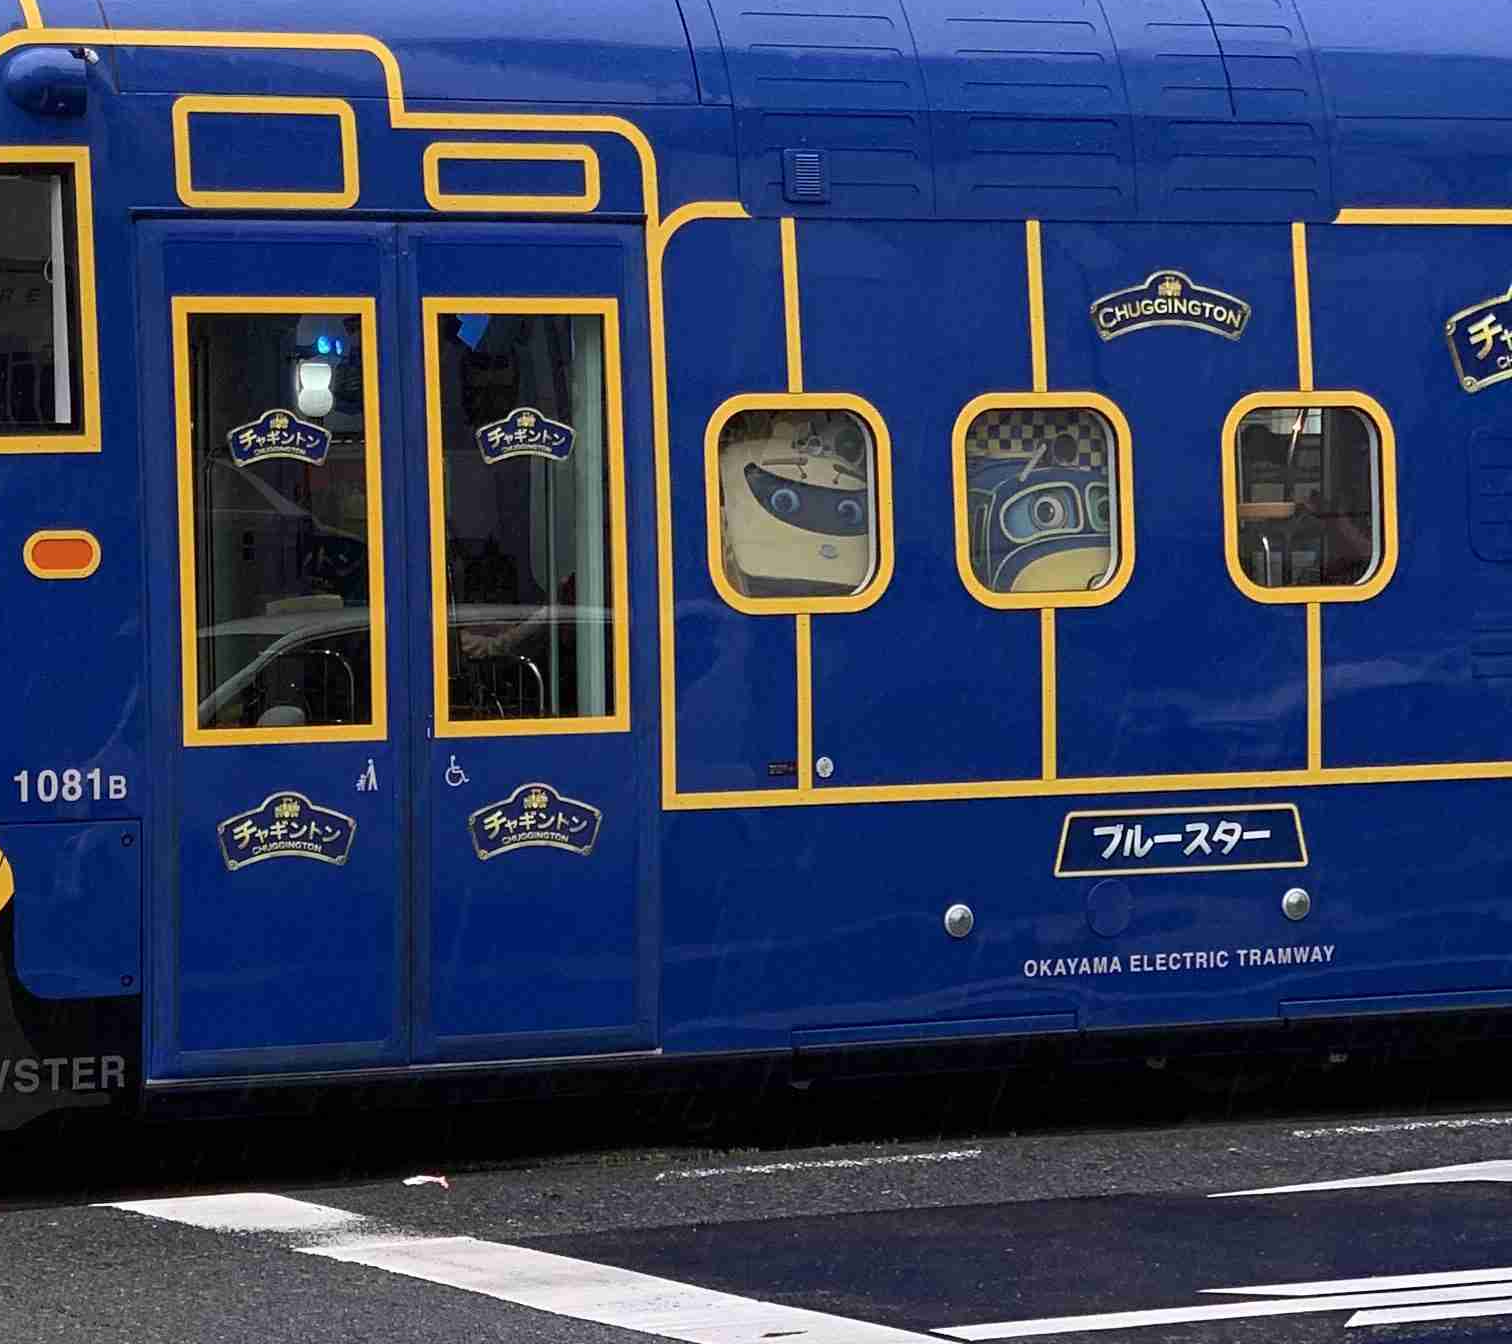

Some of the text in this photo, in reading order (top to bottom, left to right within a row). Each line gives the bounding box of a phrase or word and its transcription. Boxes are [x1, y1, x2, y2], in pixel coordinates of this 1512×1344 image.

[1099, 297, 1242, 329] CHUGGINGTON
[238, 429, 320, 452] チャギントン
[487, 427, 566, 448] チャギントン
[13, 767, 128, 803] 1081B
[232, 819, 341, 849] チャギントン
[483, 810, 587, 840] チャギントン
[1093, 819, 1272, 860] ブルースター
[1023, 944, 1336, 978] OKAYAMA ELECTRIC TRAMWAY
